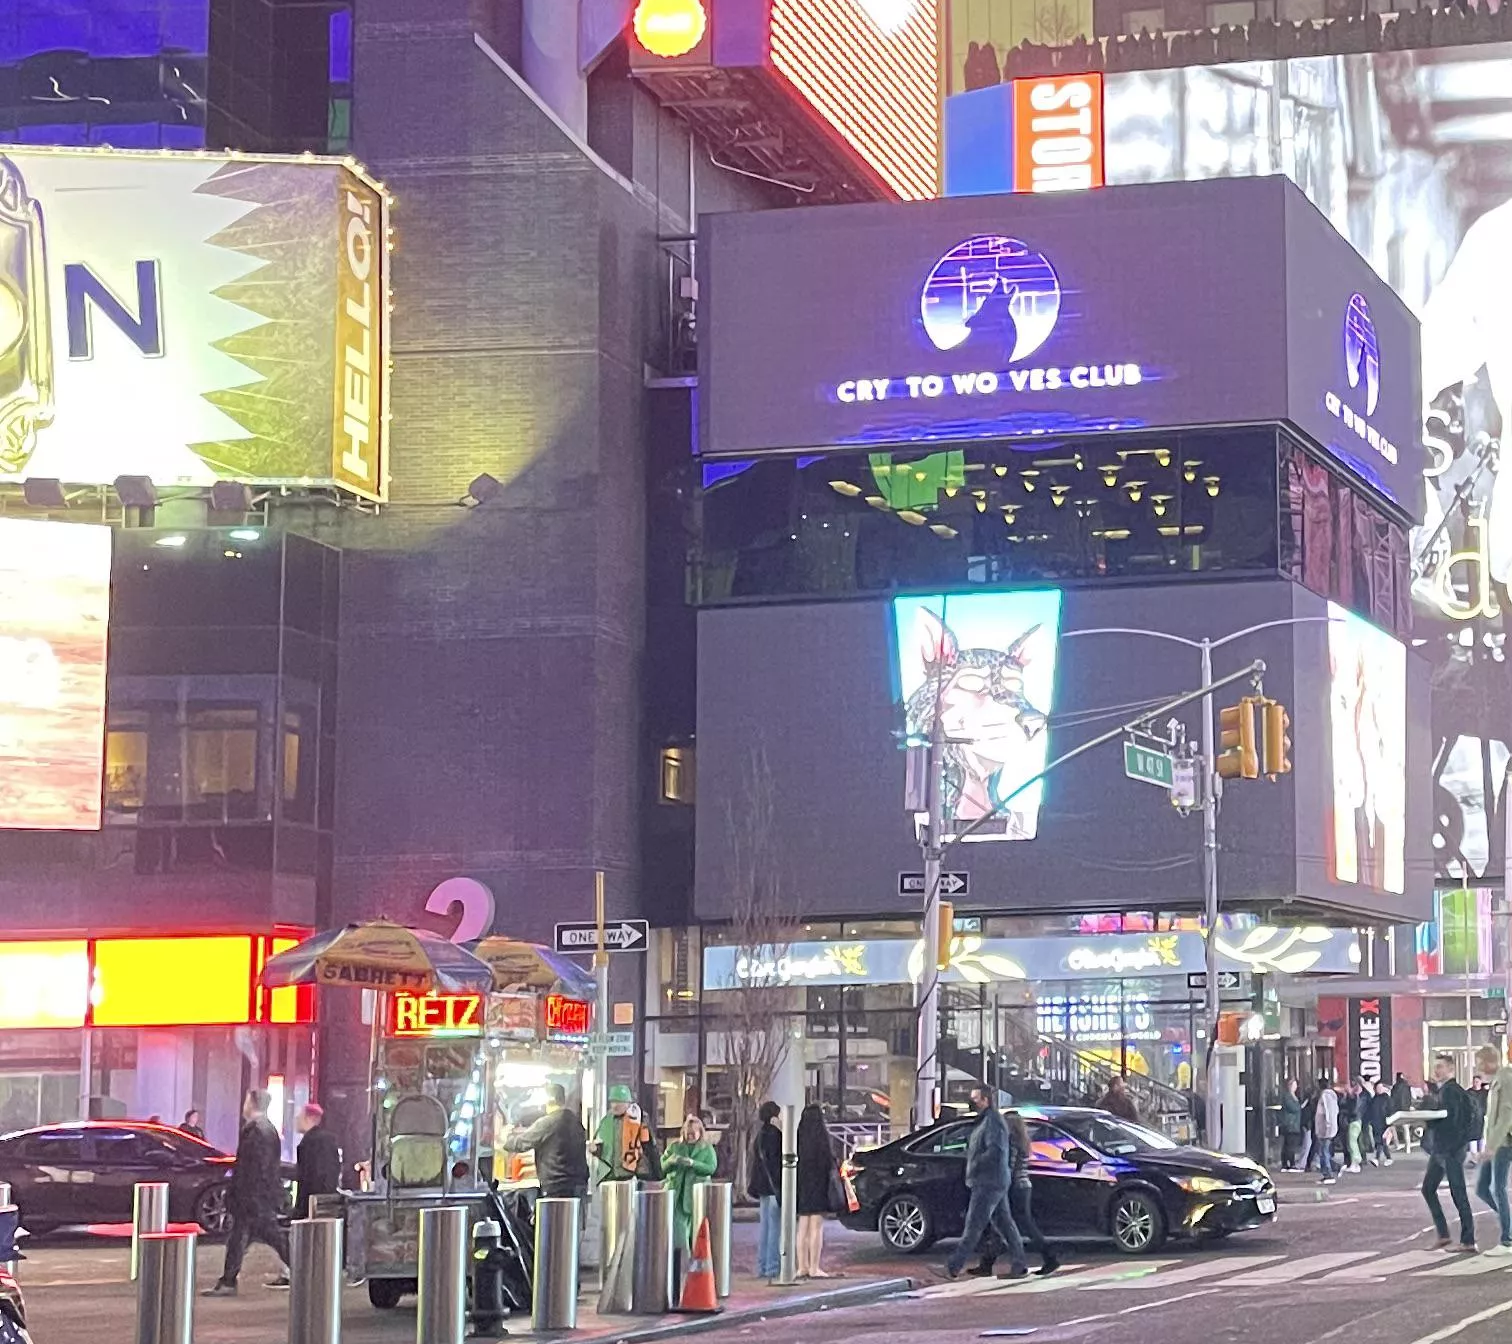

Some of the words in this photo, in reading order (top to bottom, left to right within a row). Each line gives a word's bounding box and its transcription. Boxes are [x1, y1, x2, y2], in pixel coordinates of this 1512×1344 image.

[63, 259, 164, 360] N
[342, 191, 371, 480] HELLO!
[837, 380, 890, 402] CRY
[906, 375, 944, 398] TO
[952, 372, 999, 395] WO
[1009, 368, 1062, 391] VES
[1069, 364, 1141, 389] CLUB
[569, 931, 594, 943] ONE
[606, 930, 633, 942] WAY
[322, 963, 428, 988] SABRETT
[396, 995, 480, 1029] RETZ
